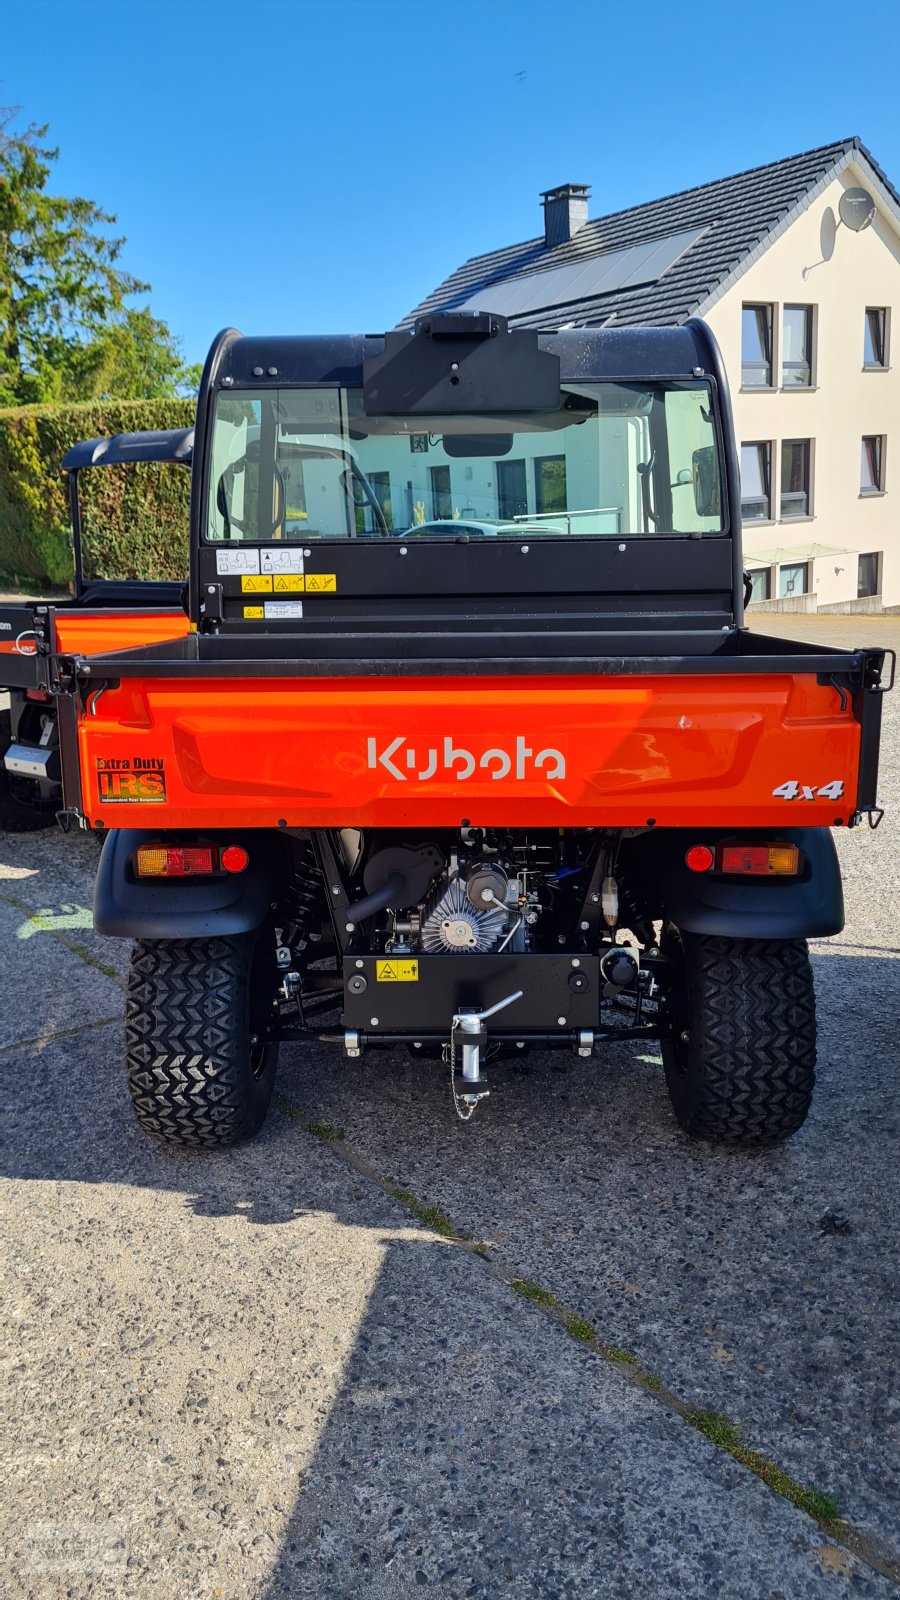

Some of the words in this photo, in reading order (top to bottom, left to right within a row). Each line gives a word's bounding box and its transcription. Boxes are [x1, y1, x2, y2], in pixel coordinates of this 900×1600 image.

[97, 757, 130, 769] Extra
[133, 757, 164, 769] Duty
[367, 736, 566, 780] Kubota
[100, 773, 164, 795] IRS
[772, 780, 845, 800] 4x4
